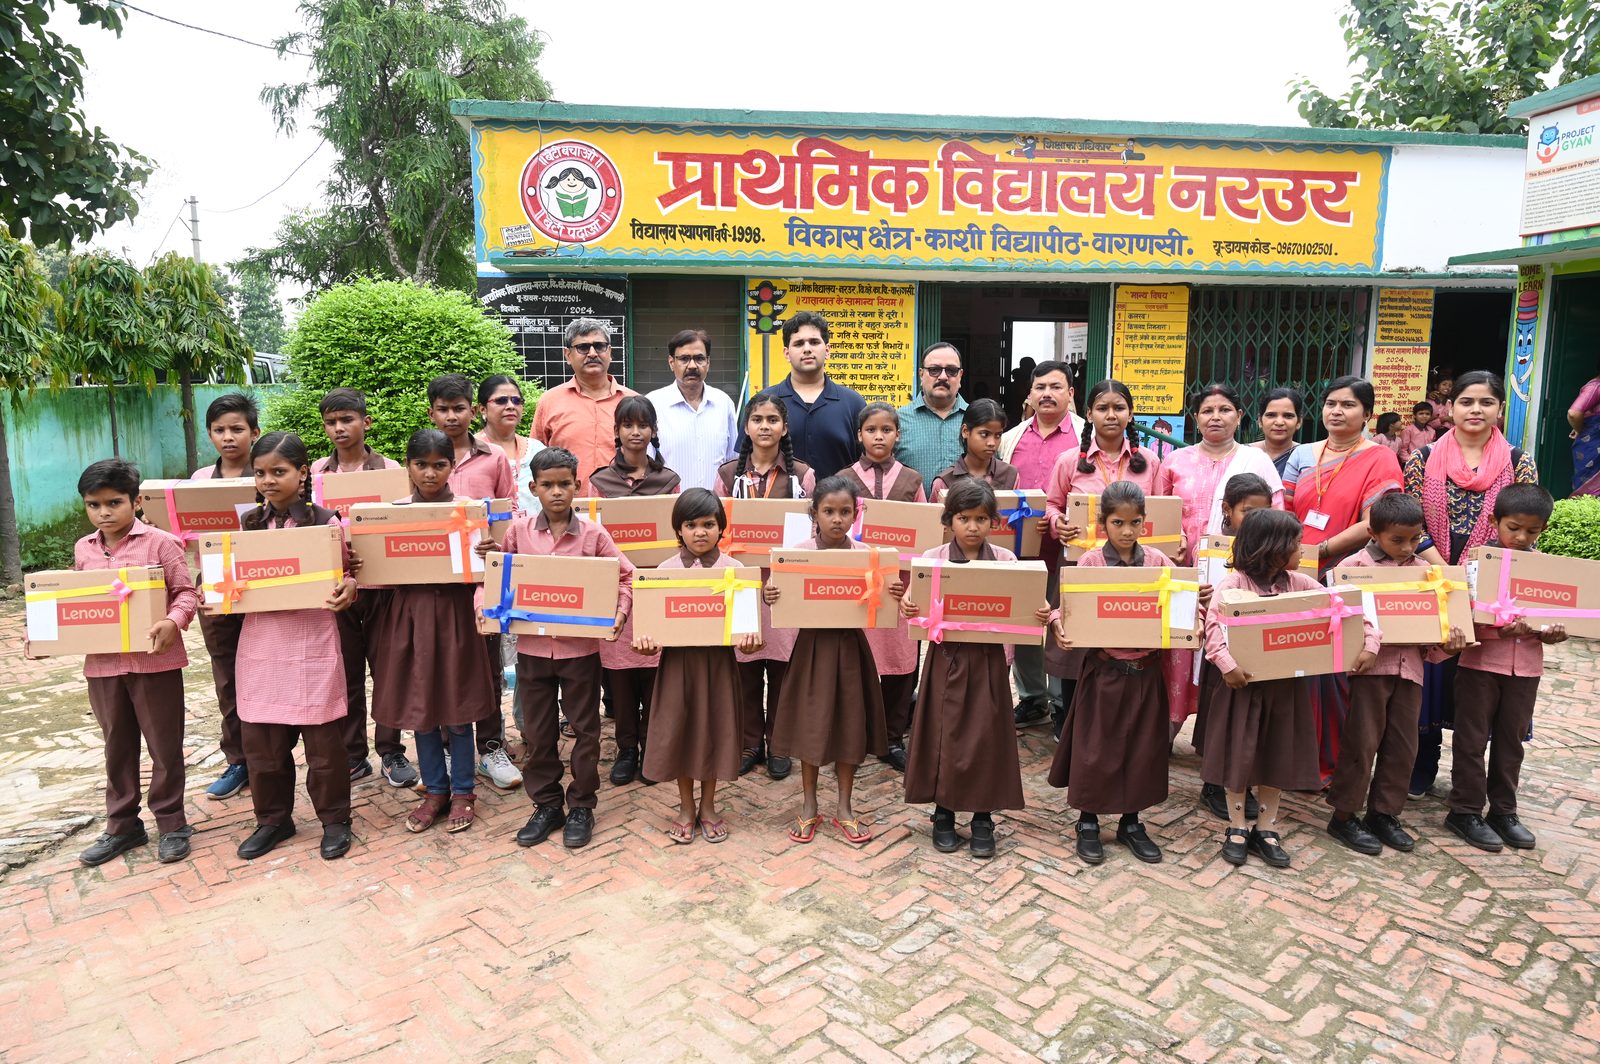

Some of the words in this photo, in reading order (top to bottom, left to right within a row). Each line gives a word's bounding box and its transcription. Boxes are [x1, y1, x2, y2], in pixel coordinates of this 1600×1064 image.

[1561, 125, 1596, 140] PROJECT
[1562, 135, 1592, 151] GYAN
[562, 147, 598, 161] बचाओ
[655, 137, 930, 214] प्राथमिक
[937, 140, 1163, 216] विद्यालय
[1169, 166, 1358, 223] नरउर
[630, 218, 677, 244] विद्यालय
[784, 216, 866, 250] विकास
[1520, 264, 1540, 276] COME
[1519, 280, 1544, 293] LEARN
[836, 294, 843, 306] के
[844, 298, 875, 306] सामान्य
[877, 296, 898, 306] नियम
[570, 306, 595, 314] 2024.
[850, 308, 856, 318] से
[886, 310, 898, 320] दूरी
[837, 330, 852, 340] गति
[853, 330, 859, 339] से
[1116, 338, 1120, 346] 3
[881, 352, 888, 360] से
[868, 382, 876, 391] की
[878, 384, 896, 393] सुरक्षा
[181, 516, 233, 526] Lenovo
[611, 528, 652, 538] enovo
[732, 528, 778, 539] Lenovo
[864, 528, 911, 543] Lenovo
[391, 540, 446, 552] Lenovo
[239, 566, 294, 578] Lenovo
[810, 584, 862, 595] Lenovo
[1516, 584, 1571, 602] Lenovo
[523, 588, 578, 604] Lenovo
[671, 600, 724, 613] Lenovo
[950, 598, 1006, 612] Lenovo
[1103, 602, 1159, 614] Lenovo
[1377, 599, 1432, 611] Lenovo
[62, 607, 114, 620] Lenovo
[1268, 630, 1325, 646] Lenovo
